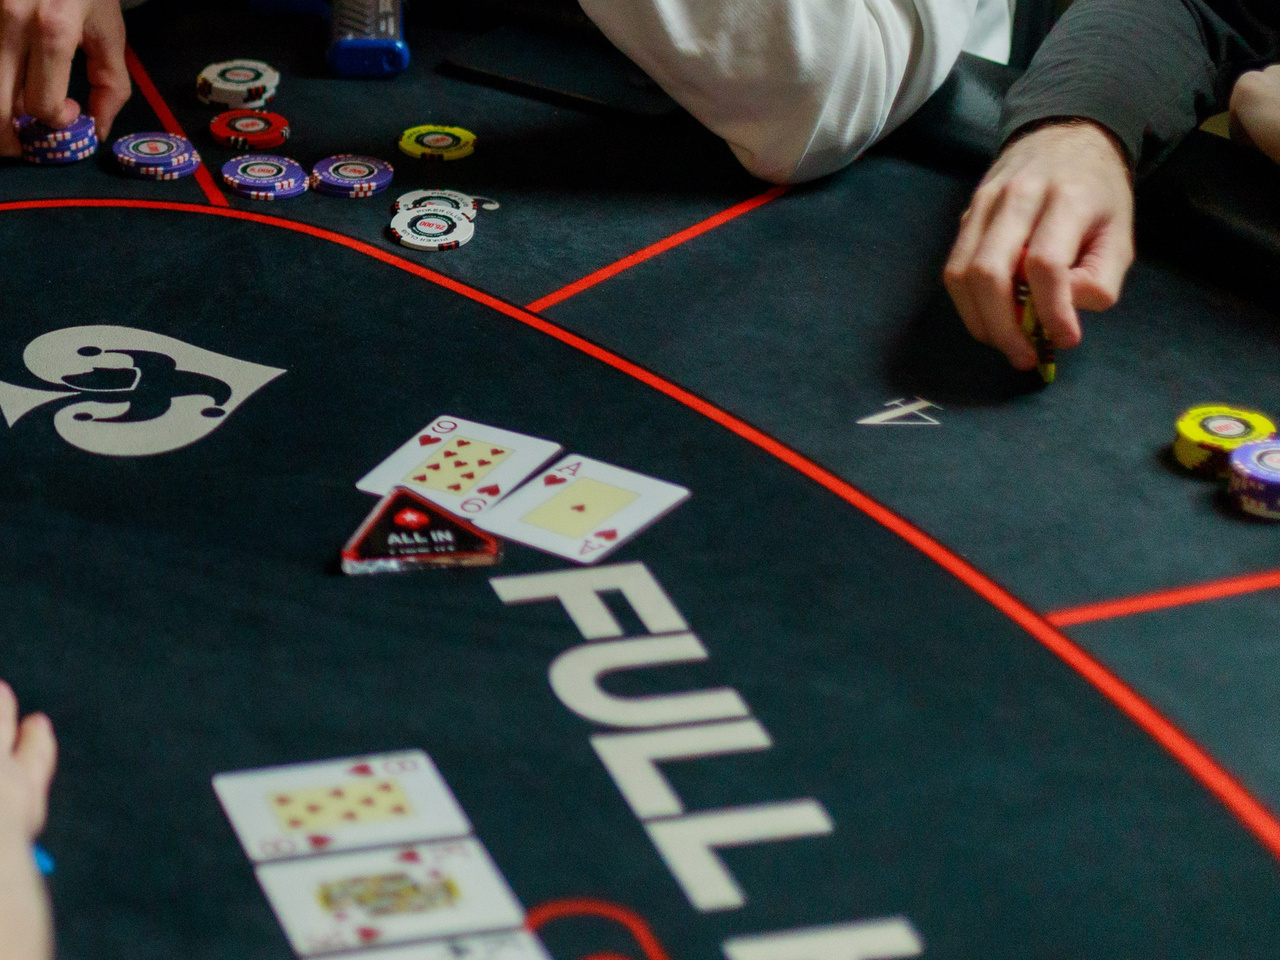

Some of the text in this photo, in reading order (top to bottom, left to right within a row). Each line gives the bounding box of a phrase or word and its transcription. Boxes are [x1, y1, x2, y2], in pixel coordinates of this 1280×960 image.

[431, 419, 458, 434] 9
[554, 461, 583, 476] A
[460, 498, 487, 513] 9
[387, 530, 455, 545] ALL IN
[578, 538, 607, 555] A
[488, 562, 837, 912] FULL
